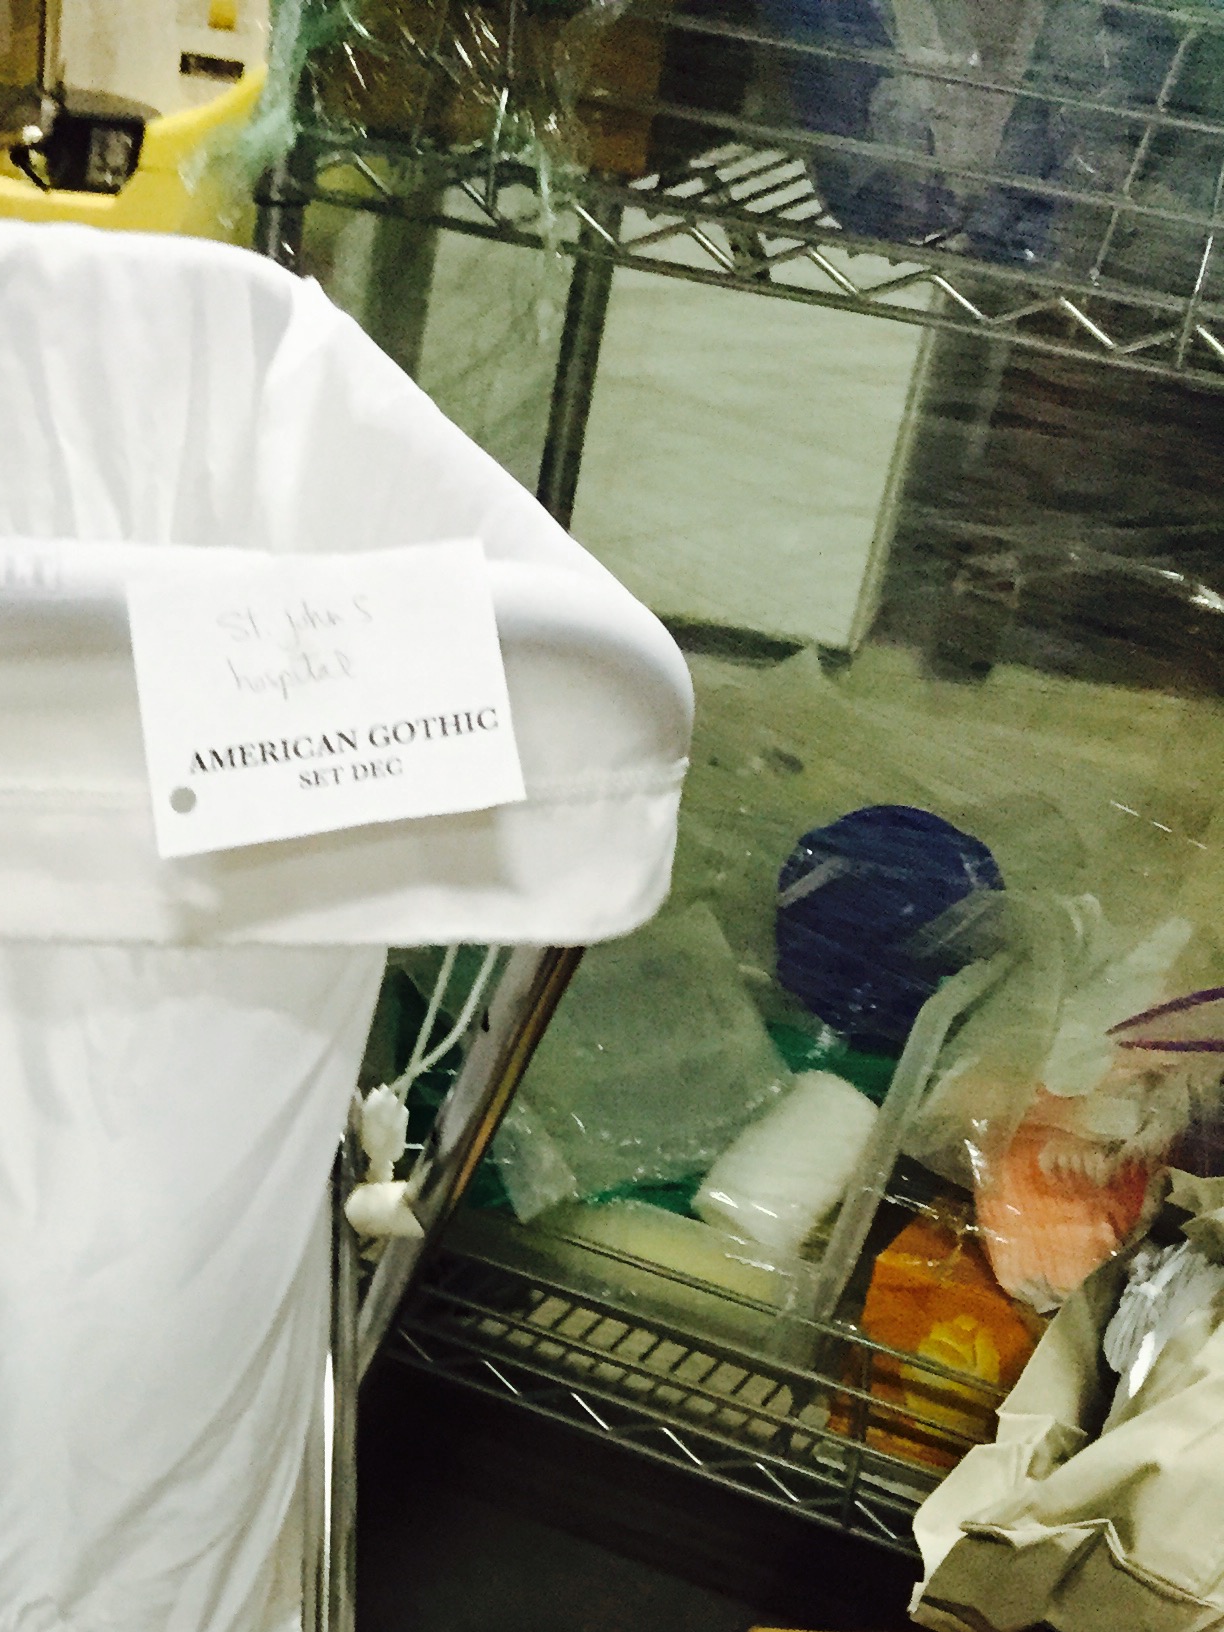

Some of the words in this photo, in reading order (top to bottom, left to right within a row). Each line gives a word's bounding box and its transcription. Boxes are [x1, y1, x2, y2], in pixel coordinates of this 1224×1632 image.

[190, 728, 360, 775] AMERICAN
[368, 706, 500, 749] GOTHIC
[298, 765, 346, 789] SET
[351, 757, 403, 783] DEC
